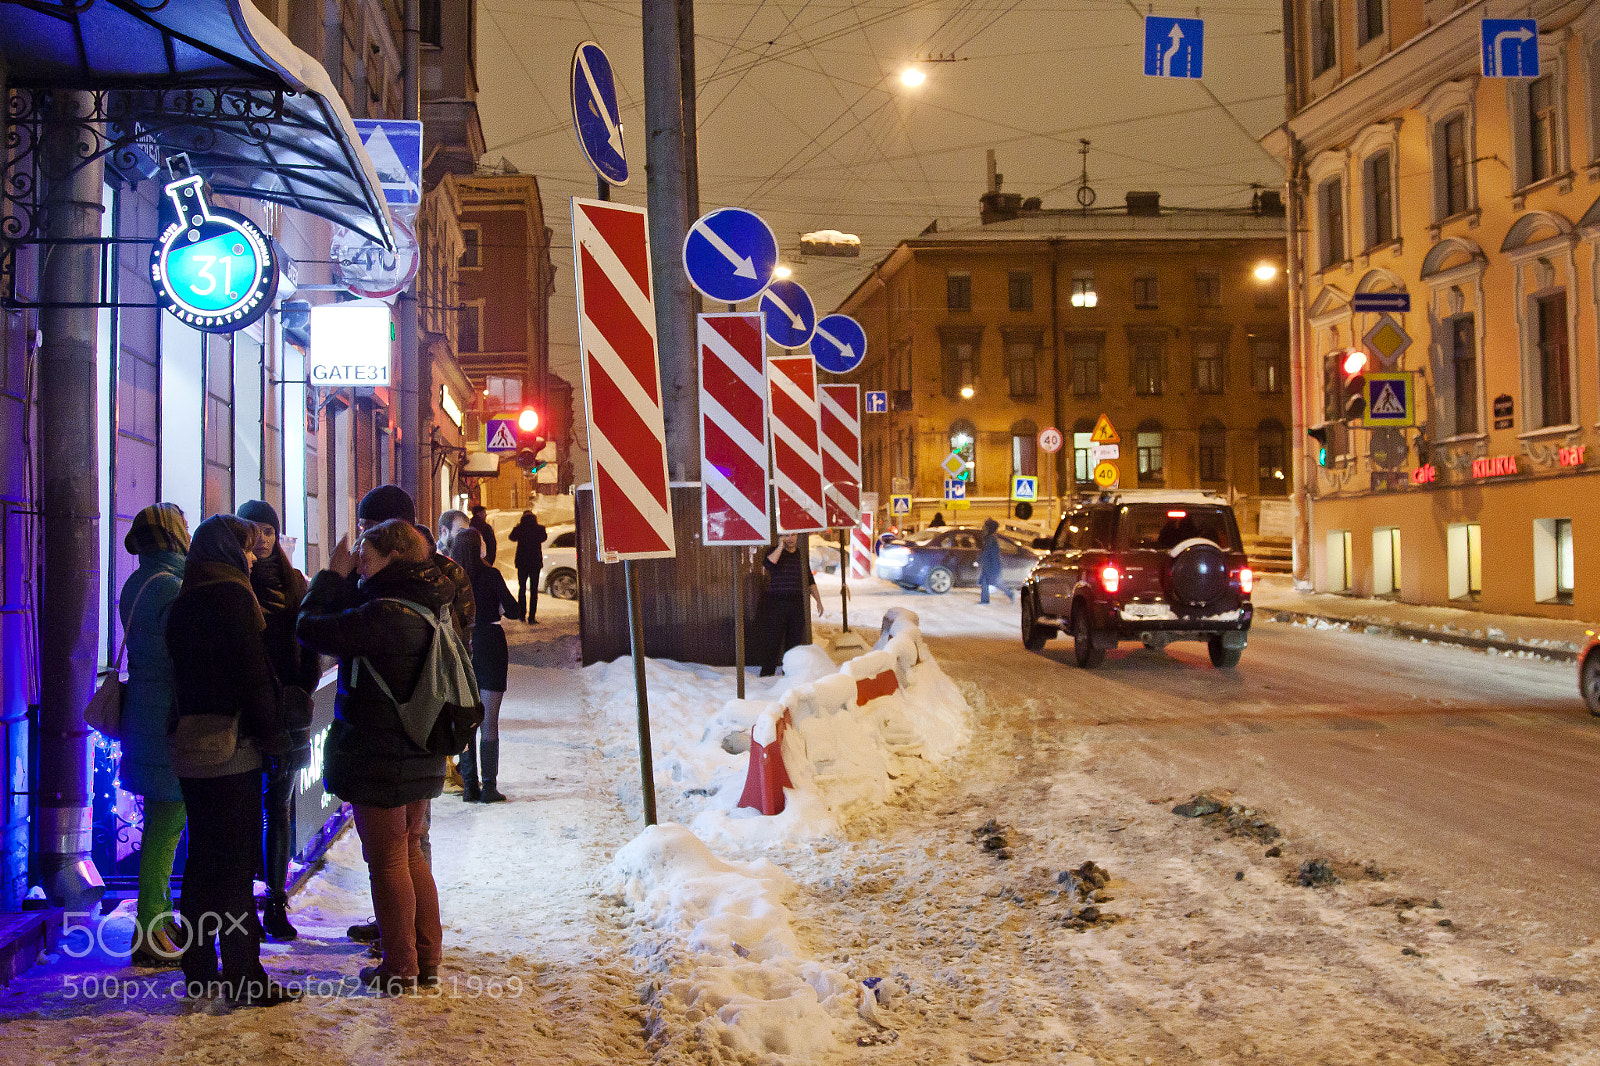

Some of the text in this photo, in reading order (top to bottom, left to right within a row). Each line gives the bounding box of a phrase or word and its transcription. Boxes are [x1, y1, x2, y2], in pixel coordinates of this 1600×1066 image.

[189, 255, 232, 296] 31
[168, 290, 264, 326] ЛАБОРАТОРИЯ
[313, 364, 387, 380] GATE31
[1044, 435, 1058, 445] 40
[1099, 469, 1113, 479] 40
[1411, 446, 1586, 484] cafe KILIKIA bar
